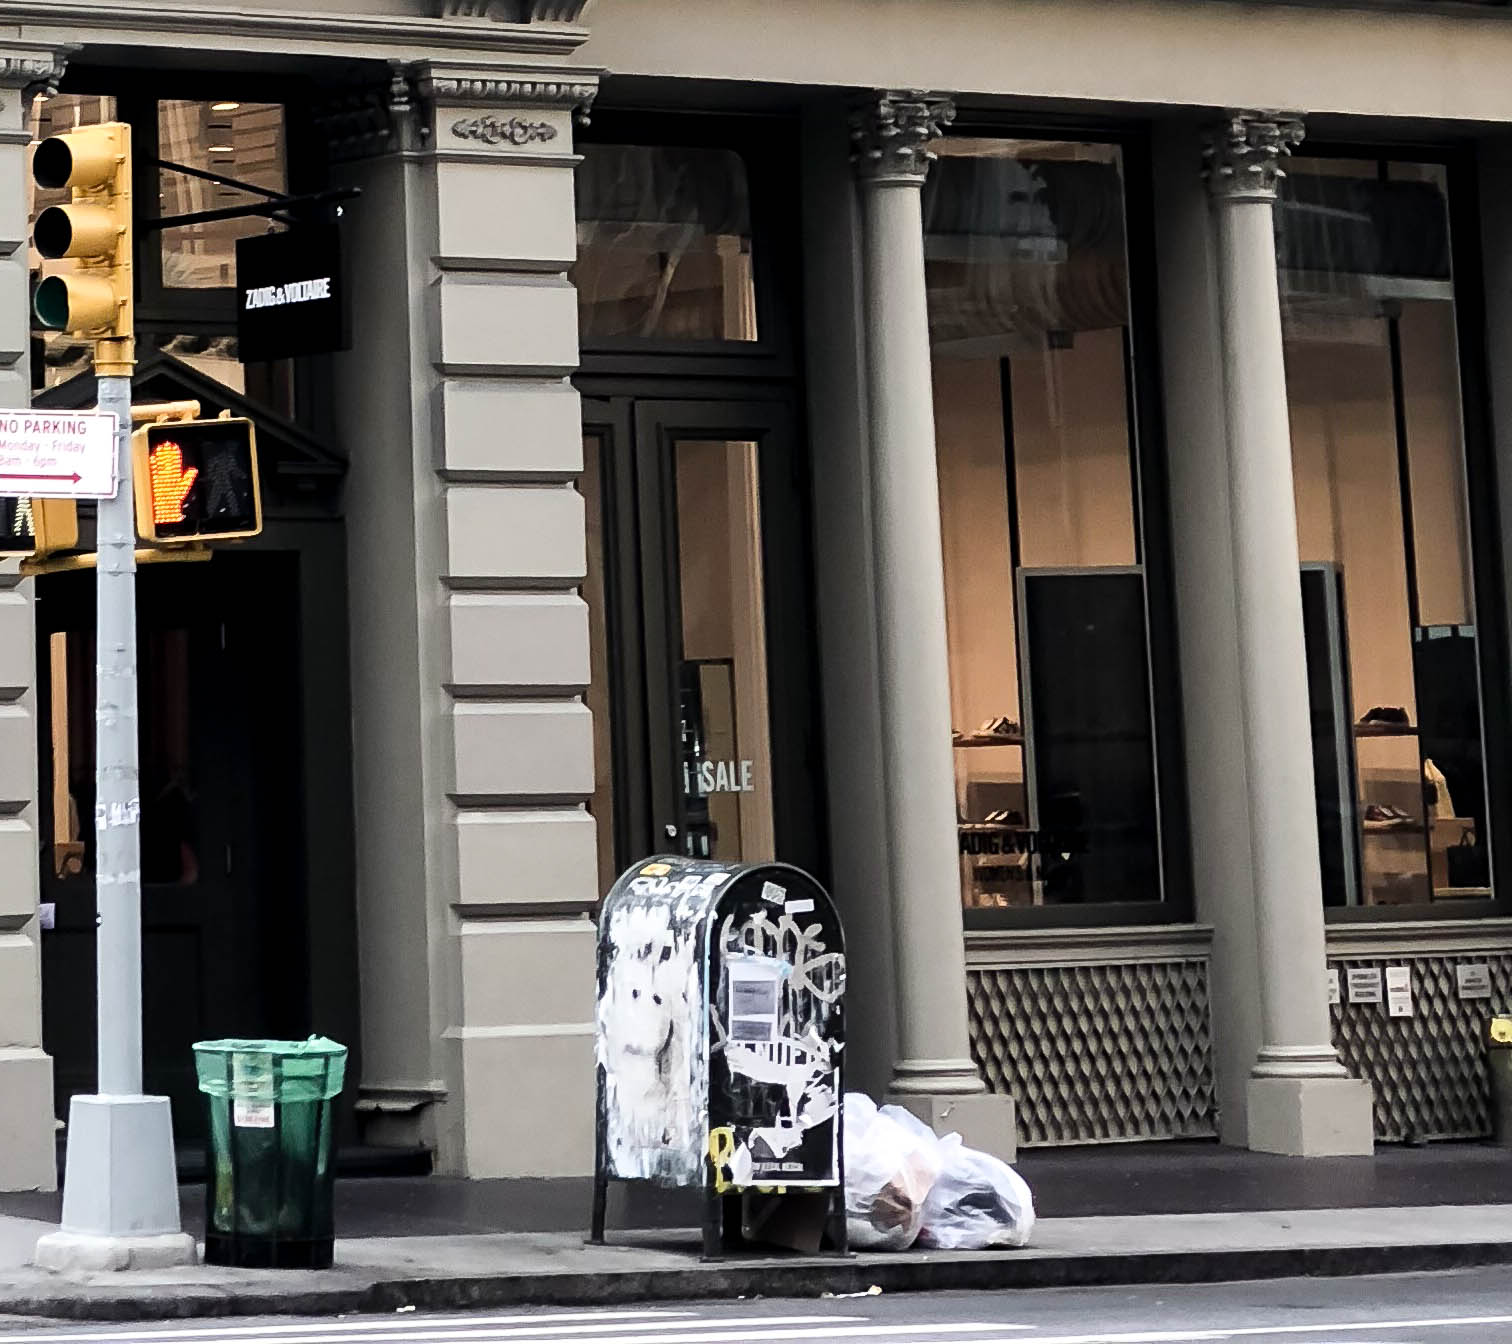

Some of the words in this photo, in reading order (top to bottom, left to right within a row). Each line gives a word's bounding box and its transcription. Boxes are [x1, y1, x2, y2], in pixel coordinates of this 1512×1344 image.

[0, 419, 19, 433] NO
[24, 419, 87, 435] PARKING
[0, 439, 40, 454] Monday
[51, 439, 86, 454] Friday
[701, 760, 755, 793] SALE
